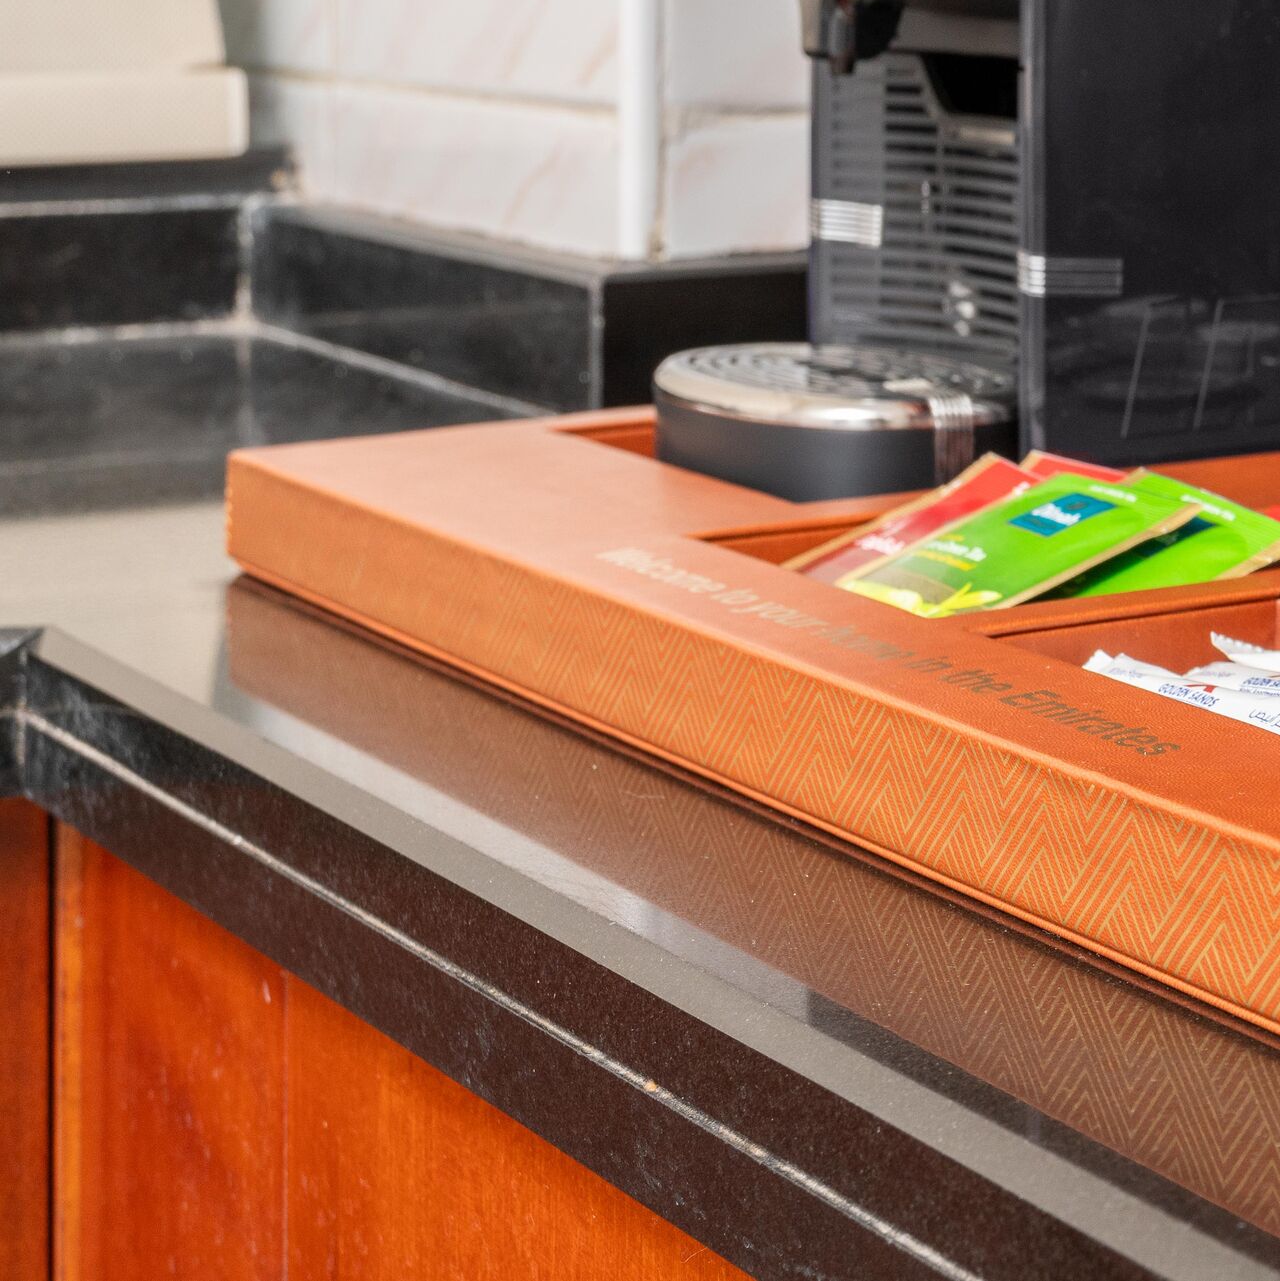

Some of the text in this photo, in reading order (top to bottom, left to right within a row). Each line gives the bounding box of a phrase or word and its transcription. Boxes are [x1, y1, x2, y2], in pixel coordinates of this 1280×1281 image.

[939, 669, 1014, 695] the
[999, 688, 1182, 756] Emirates
[1158, 683, 1220, 707] GOLDEN SANDS
